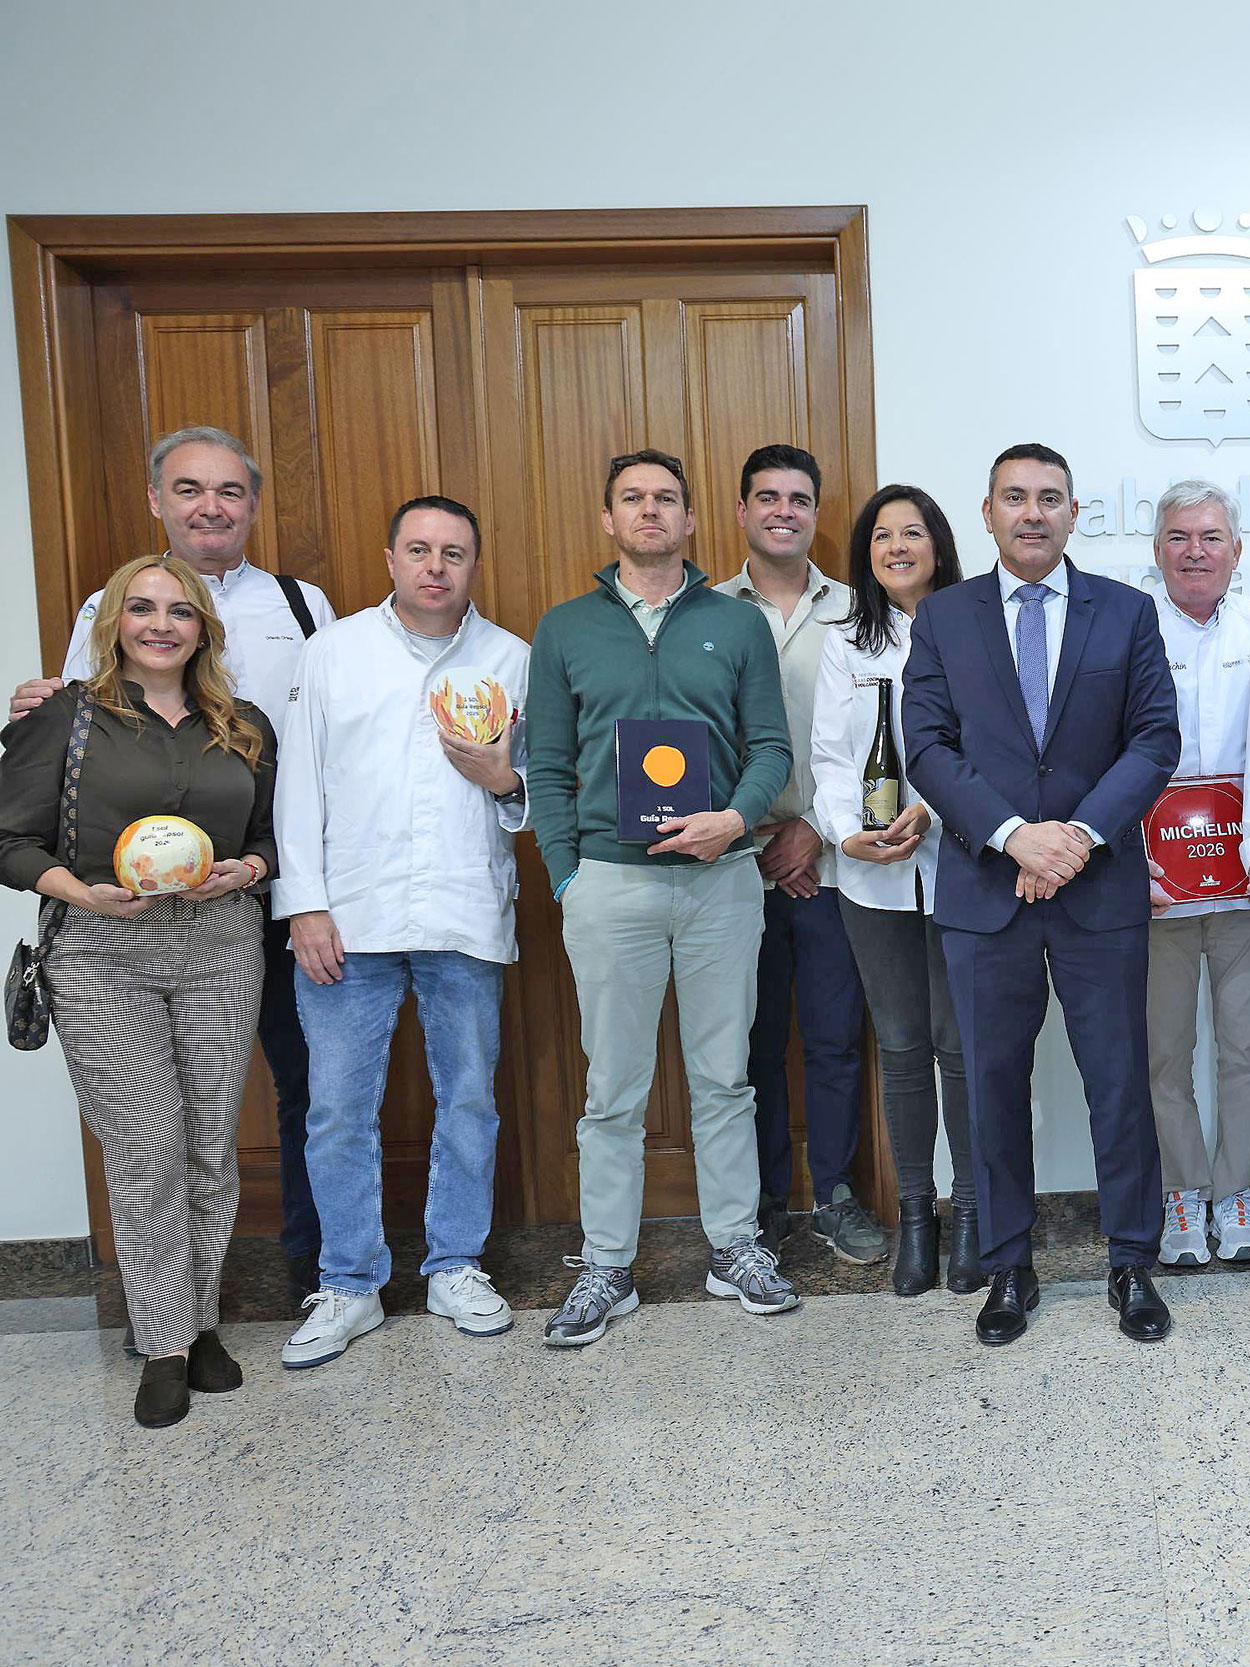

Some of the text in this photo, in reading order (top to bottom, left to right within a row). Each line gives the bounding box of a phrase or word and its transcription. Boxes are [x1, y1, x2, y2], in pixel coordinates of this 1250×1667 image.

[640, 814, 660, 823] Guía
[1160, 821, 1244, 841] MICHELIN
[1186, 842, 1225, 859] 2026
